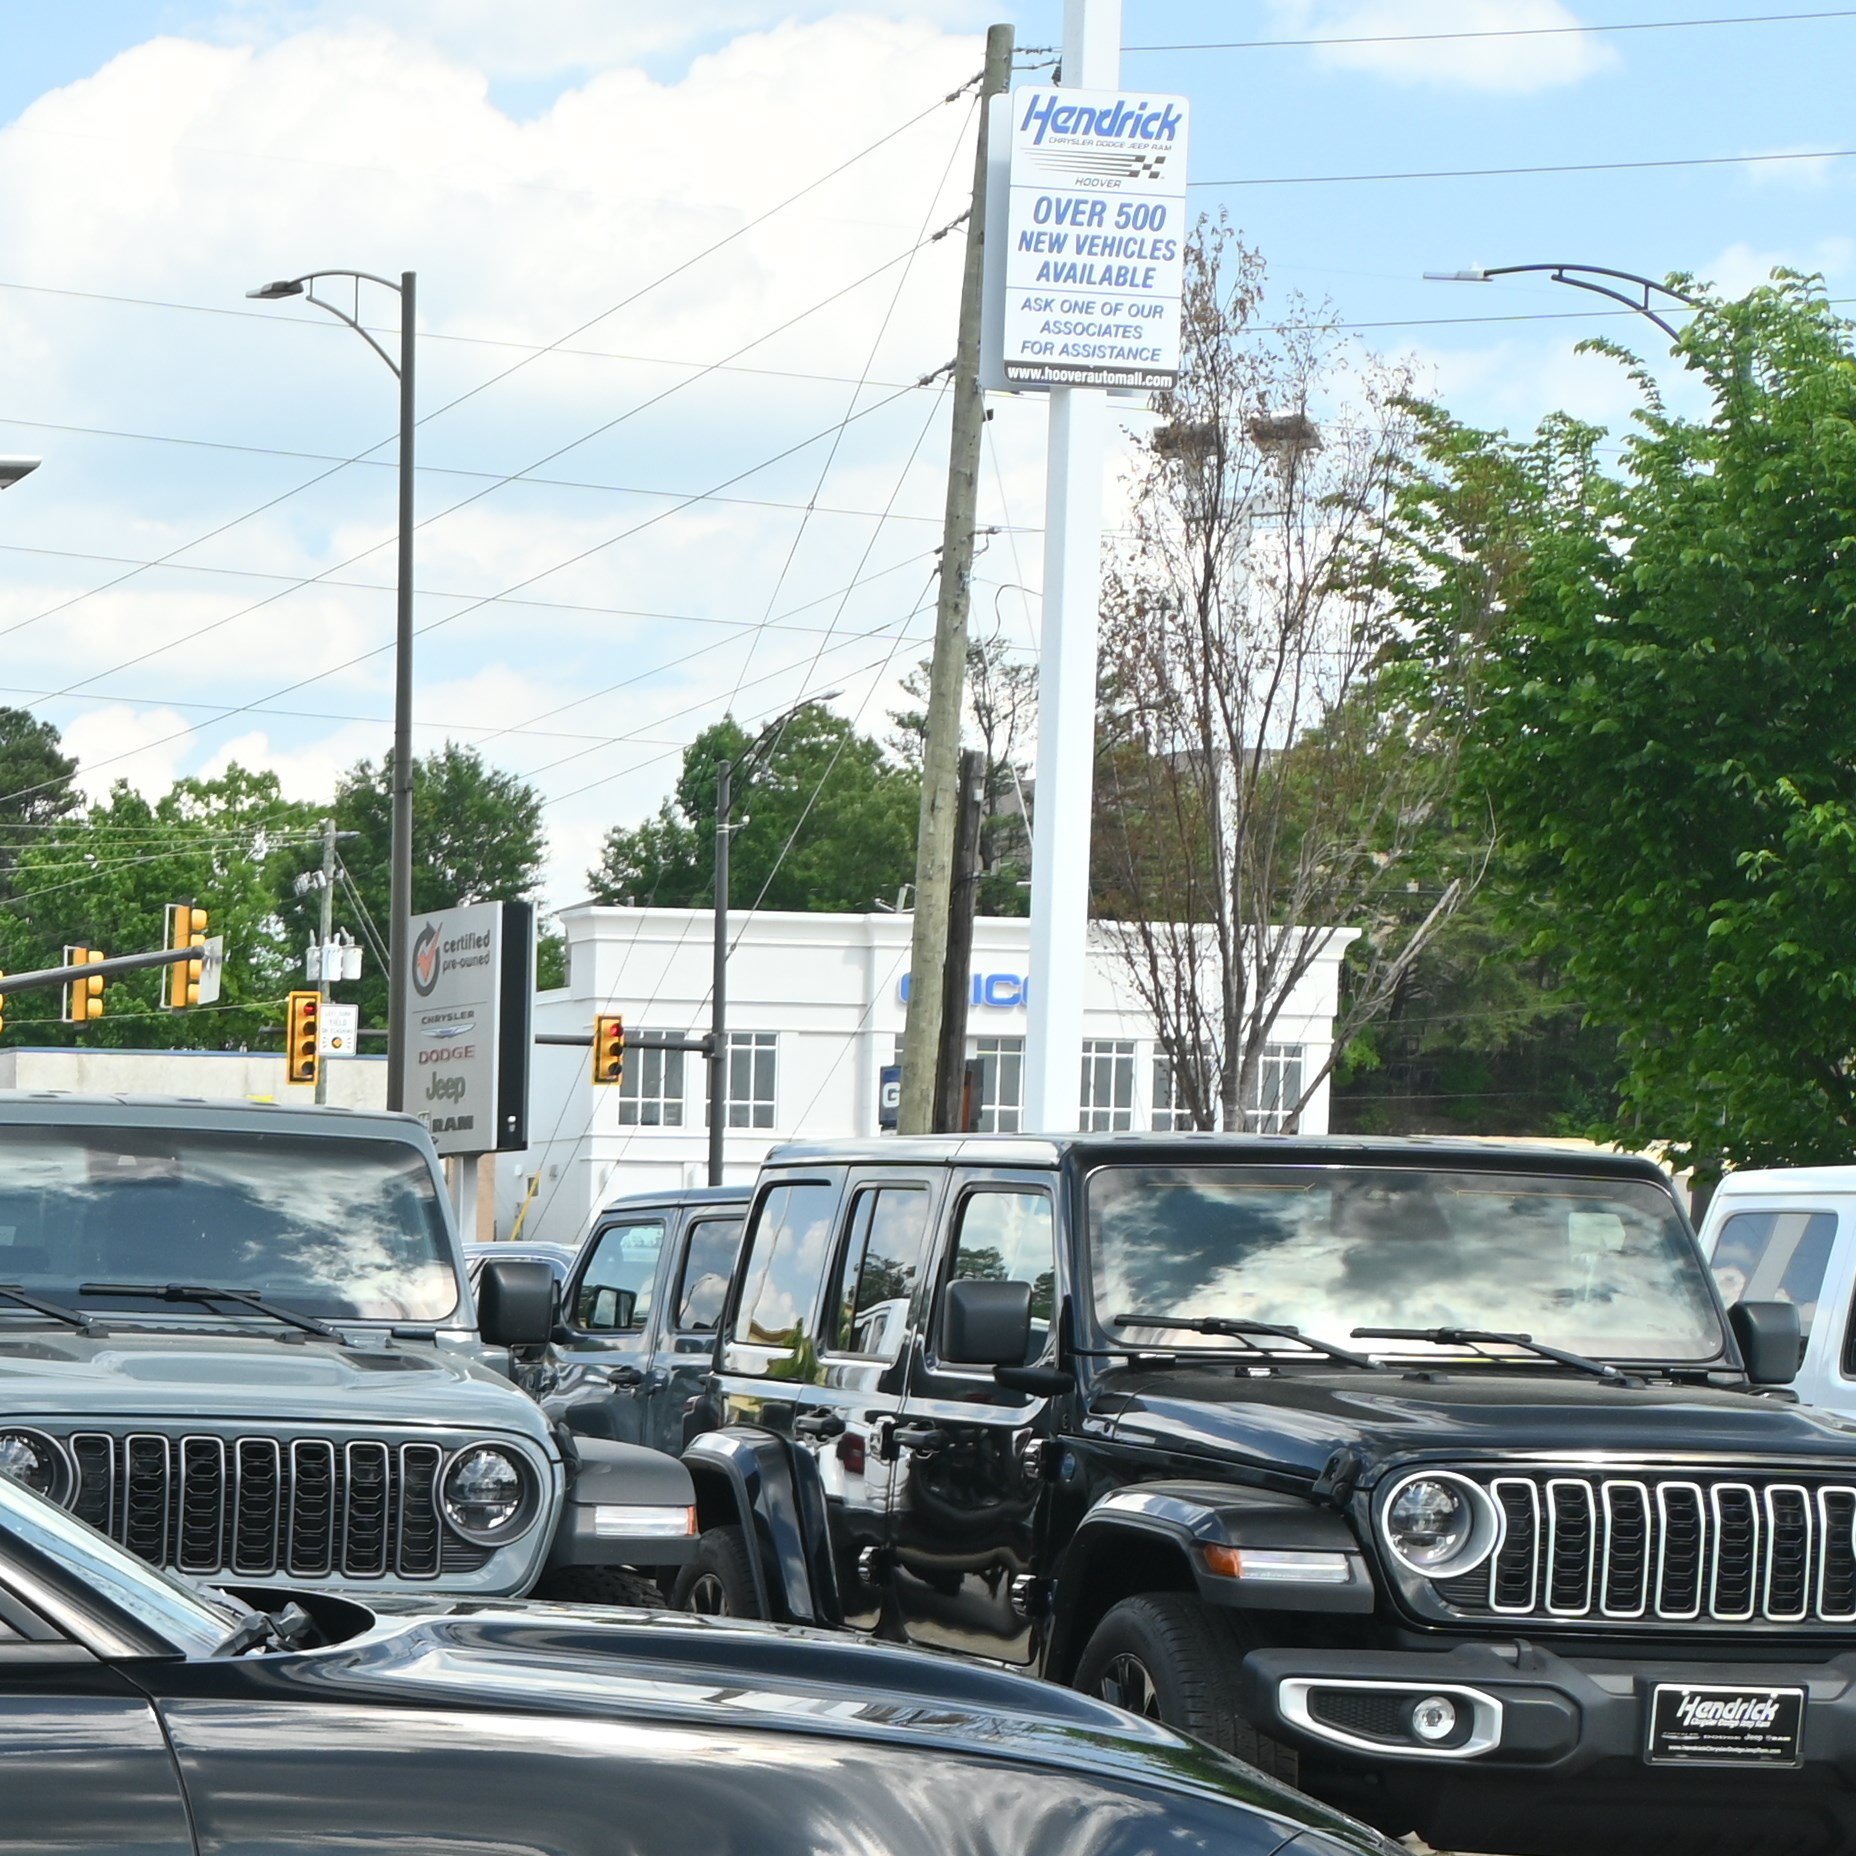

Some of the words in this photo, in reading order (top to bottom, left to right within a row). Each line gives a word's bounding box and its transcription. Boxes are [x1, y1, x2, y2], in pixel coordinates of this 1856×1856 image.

[1020, 94, 1182, 145] Hendrick
[1048, 136, 1094, 146] CHRYSLER
[1096, 140, 1126, 148] DODGE
[1128, 142, 1149, 150] JEEP
[1075, 177, 1122, 188] HOOVER
[1033, 195, 1105, 228] OVER
[1114, 202, 1166, 232] 500
[1017, 230, 1068, 255] NEW
[1075, 234, 1176, 262] VEHICLES
[1036, 260, 1156, 289] AVAILABLE
[1021, 297, 1054, 313] ASK
[1060, 299, 1095, 315] ONE
[1100, 302, 1124, 316] OF
[1127, 303, 1164, 319] OUR
[1039, 319, 1143, 340] ASSOCIATES
[1021, 340, 1055, 356] FOR
[1059, 344, 1162, 362] ASSISTANCE
[1007, 365, 1173, 388] www.hooverautomall.com
[443, 929, 491, 953] certified
[442, 951, 491, 974] pre-owned
[421, 1010, 475, 1024] CHRYSLER
[418, 1045, 476, 1065] DODGE
[426, 1071, 466, 1104] Jeep
[432, 1115, 474, 1133] RAM
[1676, 1695, 1779, 1726] Hendrick
